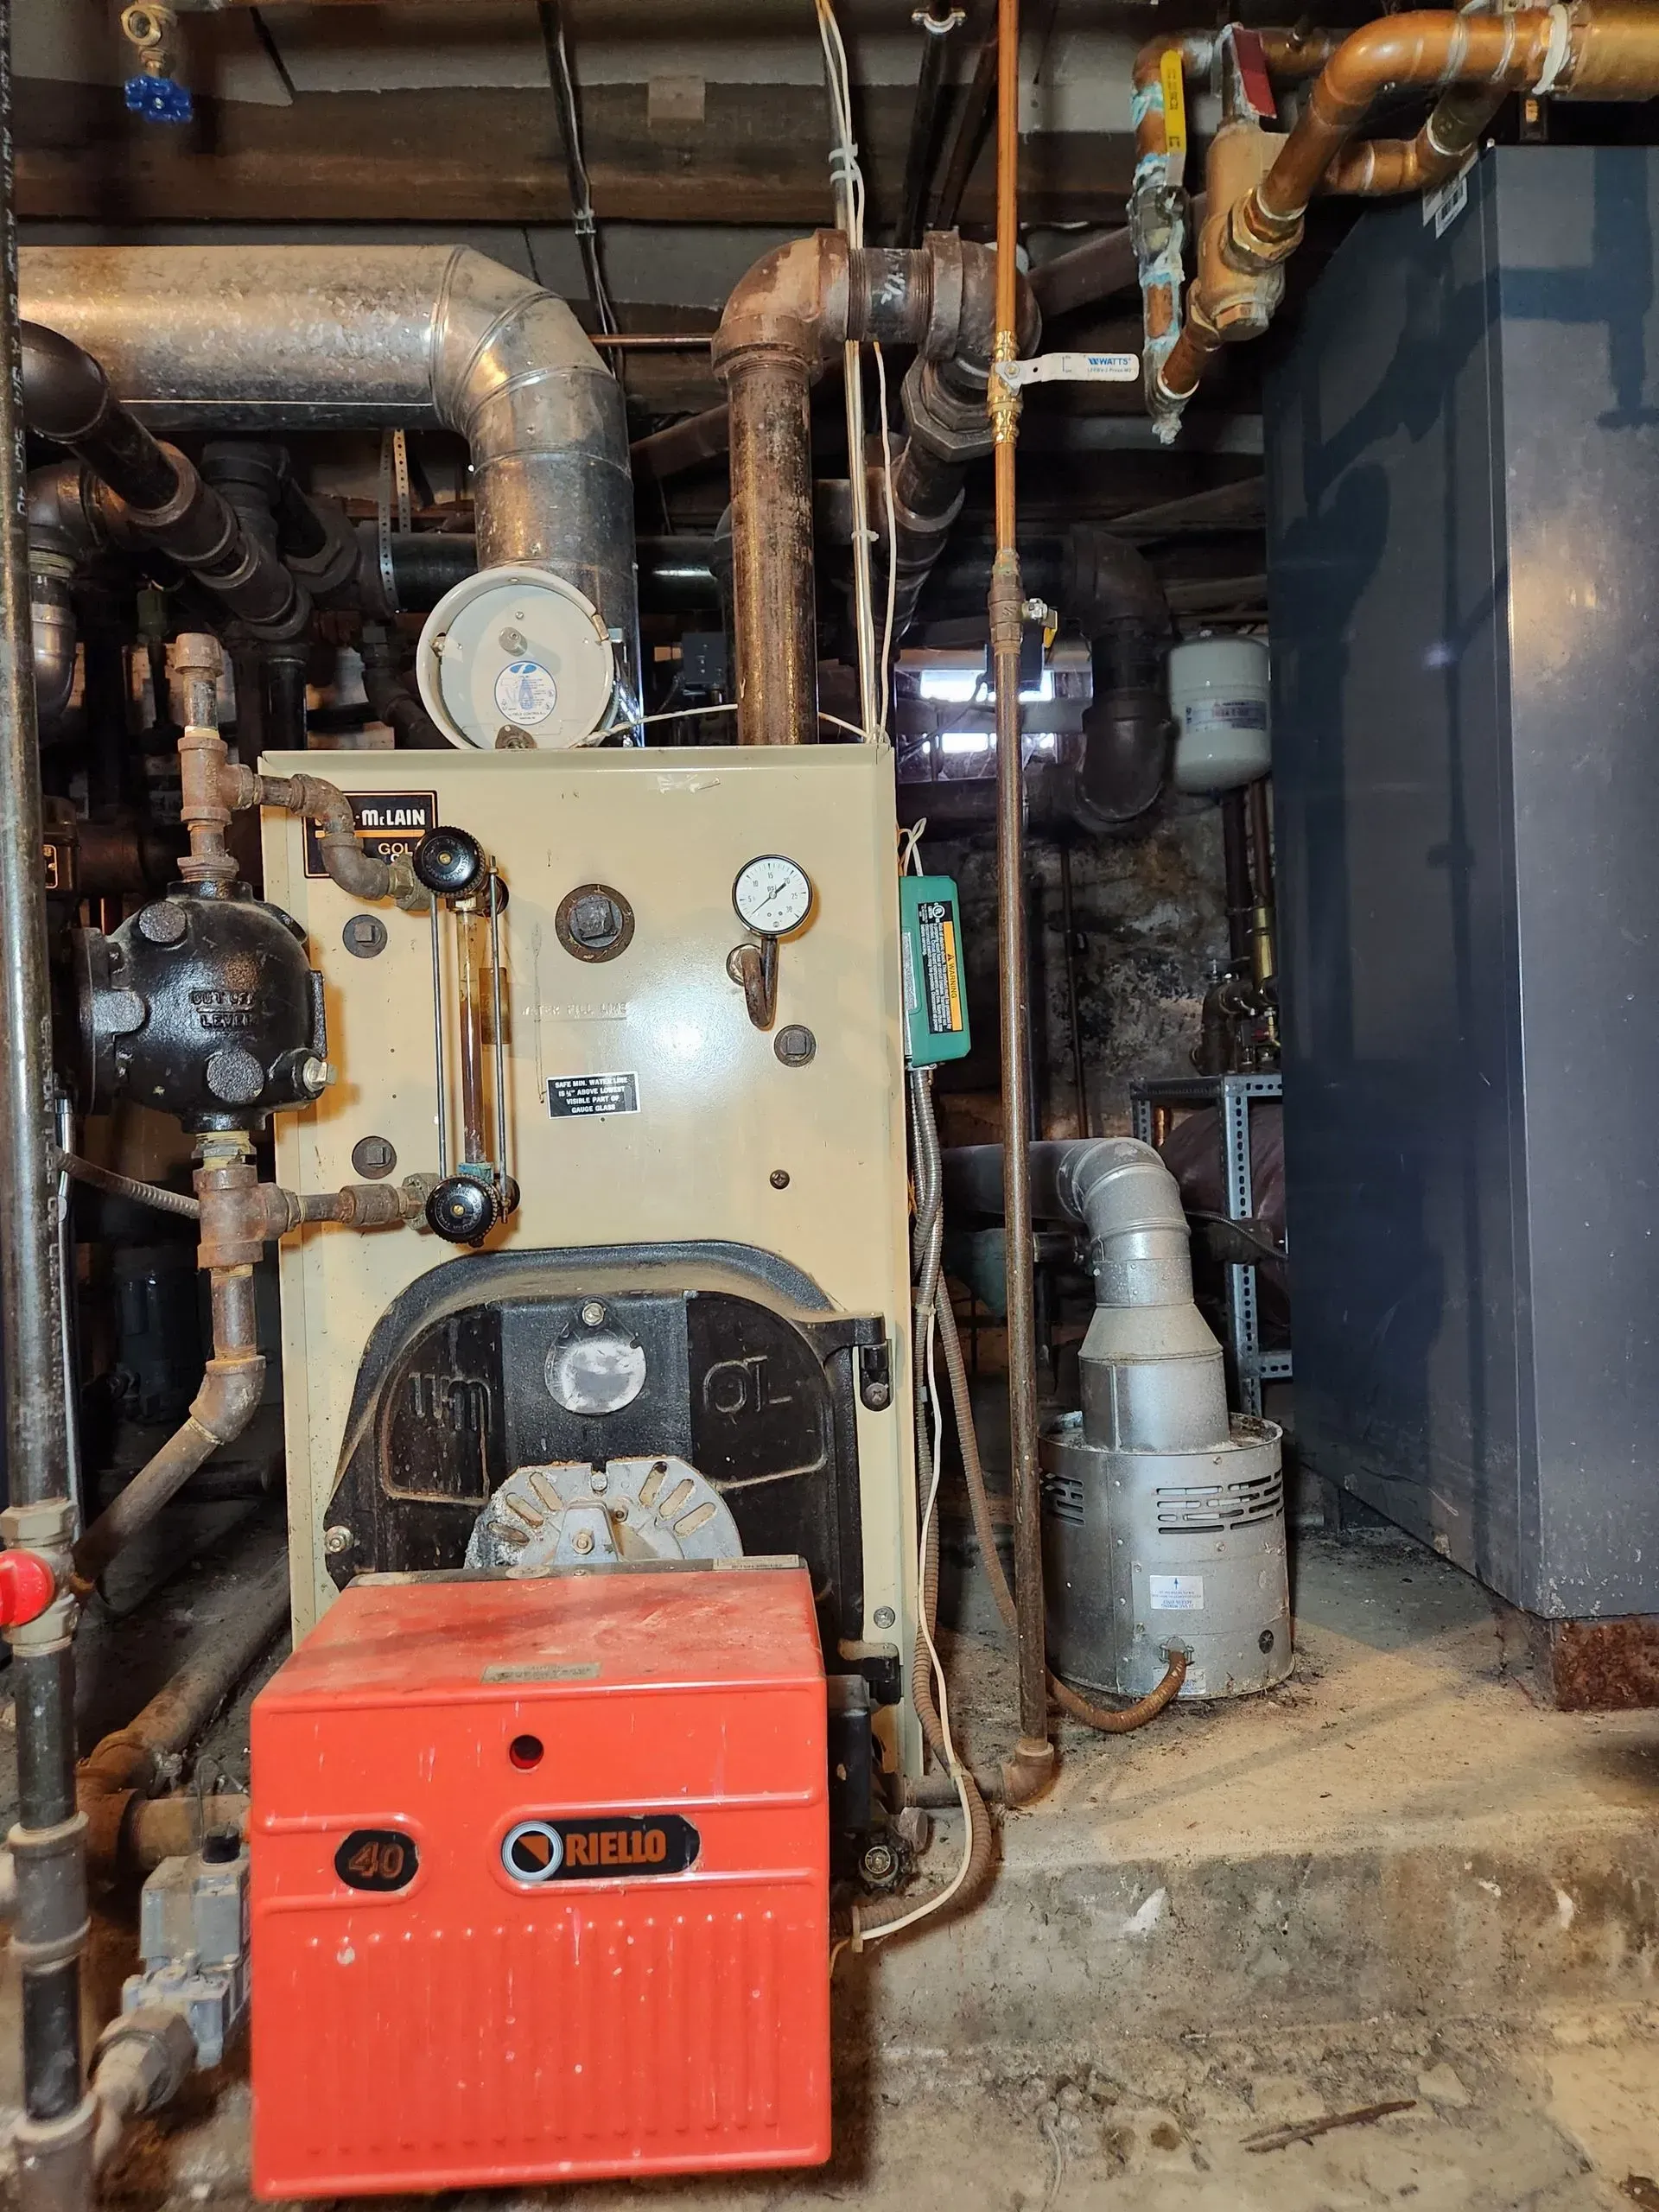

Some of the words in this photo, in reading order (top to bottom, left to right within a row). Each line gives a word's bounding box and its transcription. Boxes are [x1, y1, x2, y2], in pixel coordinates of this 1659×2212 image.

[1099, 357, 1129, 365] WATTS
[378, 842, 413, 855] GOL
[948, 962, 957, 998] WARNING
[601, 1085, 626, 1094] LOWEST
[348, 1840, 404, 1879] 40
[565, 1829, 666, 1866] RIELLO
